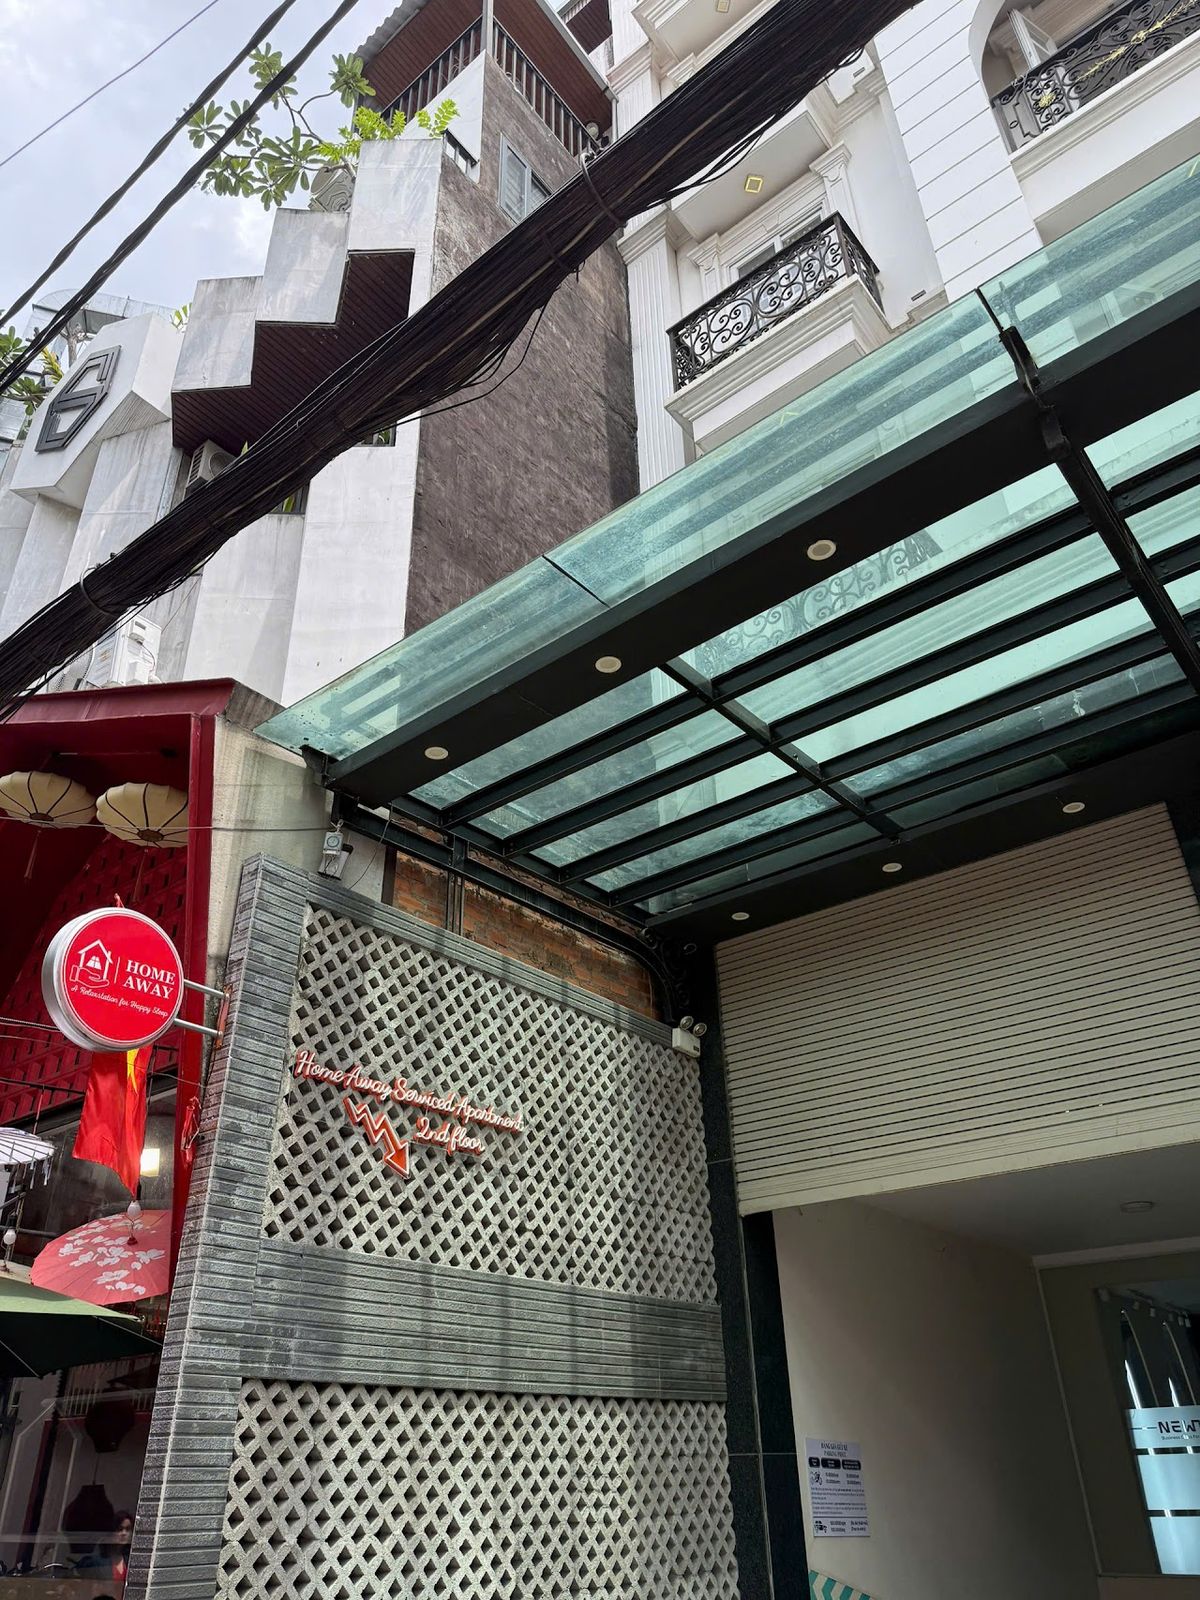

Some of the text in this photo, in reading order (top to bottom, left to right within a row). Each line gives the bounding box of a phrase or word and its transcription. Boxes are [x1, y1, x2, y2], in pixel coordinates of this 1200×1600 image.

[126, 959, 176, 985] HOME
[123, 975, 173, 999] AWAY
[118, 998, 130, 1007] for
[130, 1000, 151, 1014] Happy
[152, 1007, 168, 1019] Sleep
[294, 1050, 524, 1132] Home Away Serviced Apartment
[415, 1117, 486, 1153] 2nd floor
